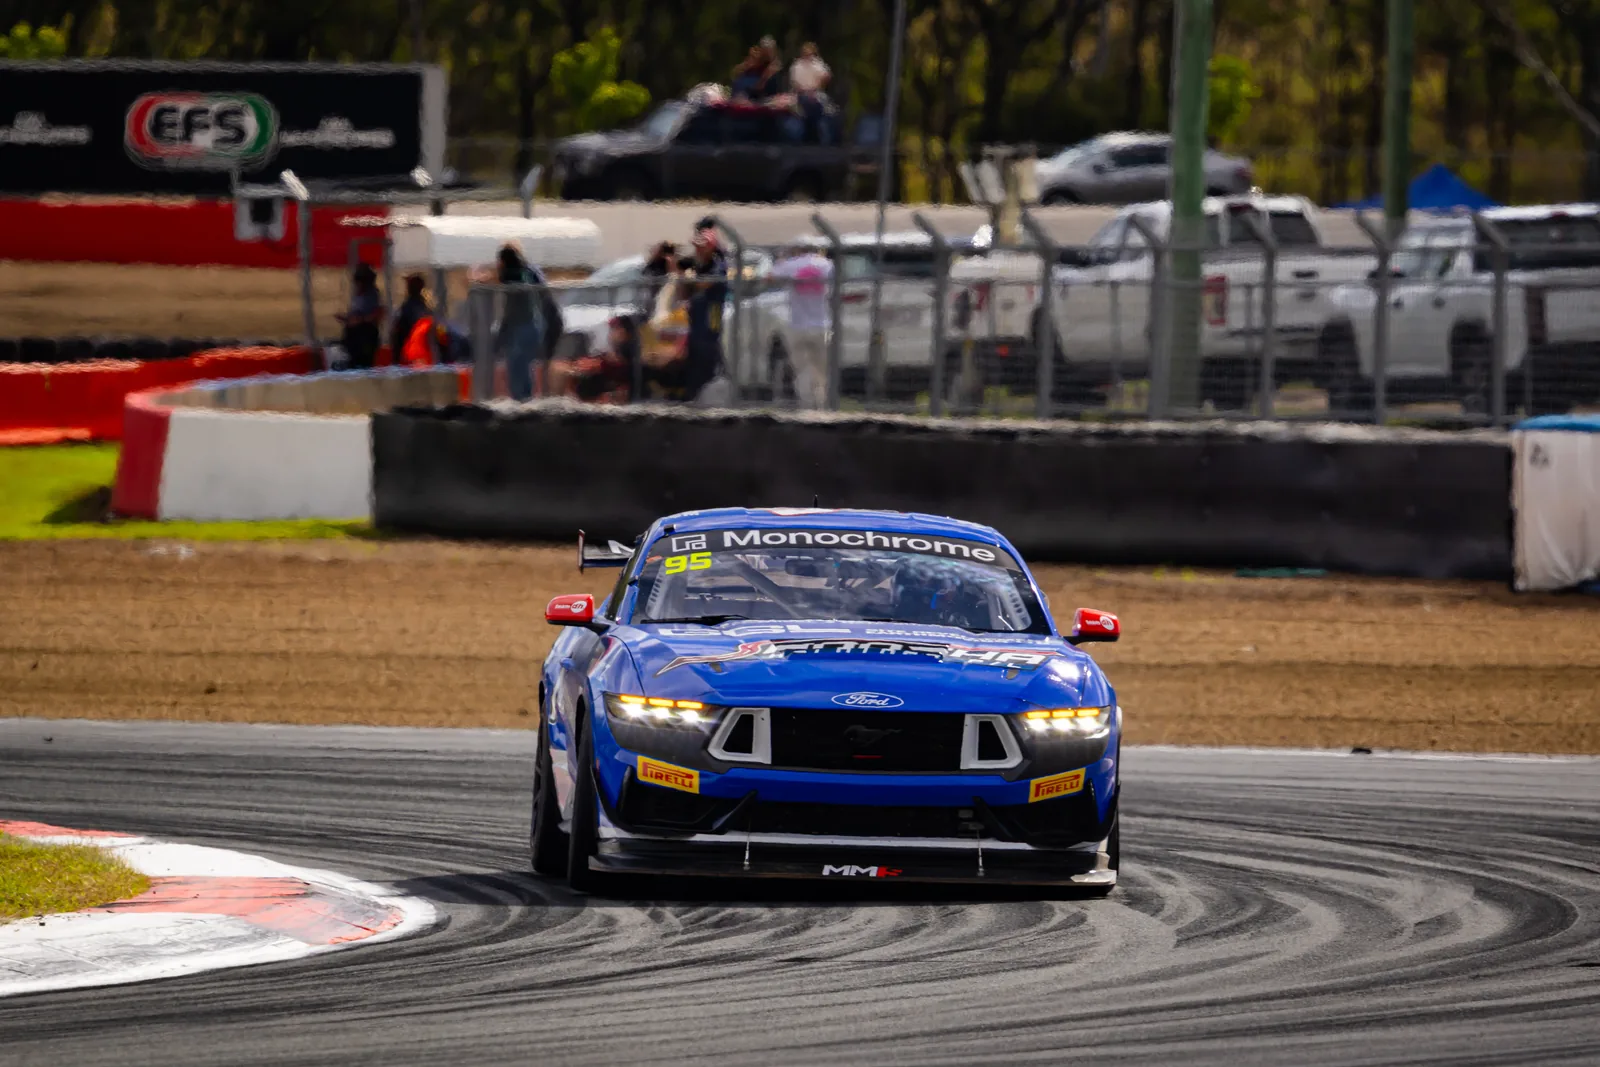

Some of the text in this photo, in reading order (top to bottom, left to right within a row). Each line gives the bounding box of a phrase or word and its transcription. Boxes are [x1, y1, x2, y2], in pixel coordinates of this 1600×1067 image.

[151, 106, 245, 144] EFS
[723, 530, 995, 561] Monochrome
[665, 552, 712, 574] 95
[845, 694, 890, 706] Ford
[642, 761, 694, 788] PIRELLI
[1034, 774, 1081, 798] PIRELLI
